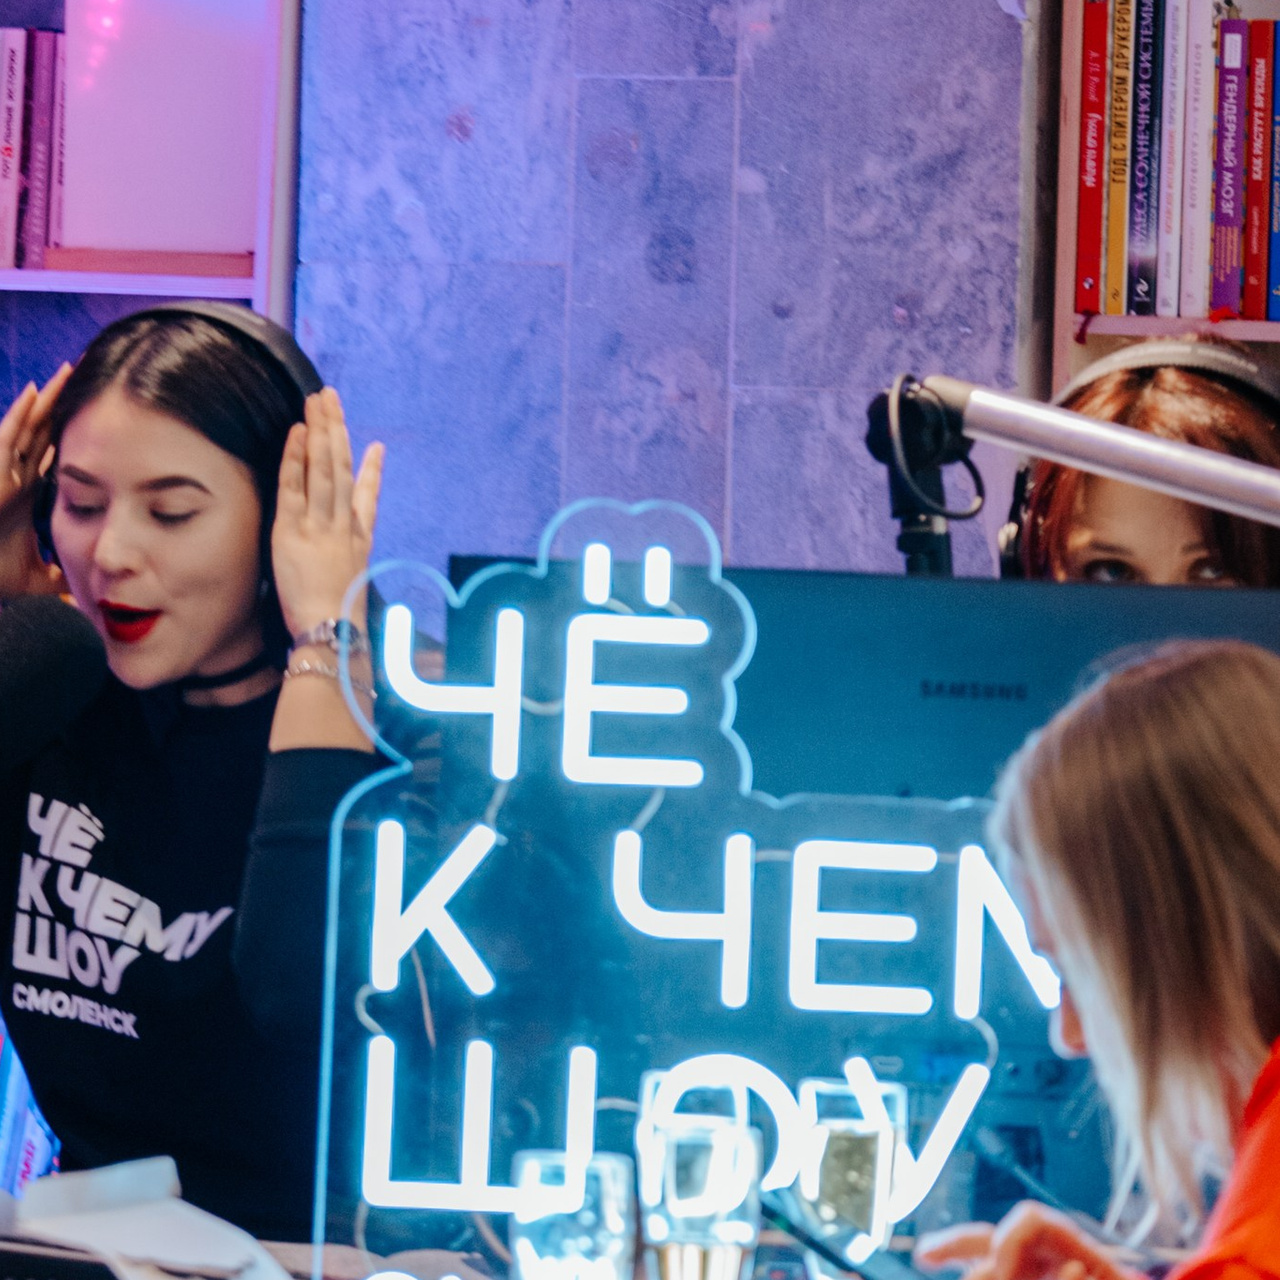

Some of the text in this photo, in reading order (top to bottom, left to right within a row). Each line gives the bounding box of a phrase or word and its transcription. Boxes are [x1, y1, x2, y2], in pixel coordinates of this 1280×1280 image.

[1113, 76, 1129, 139] ПИТЕРОМ
[1132, 83, 1151, 189] СОЛНЕЧНОЙ
[1221, 74, 1239, 167] ГЕНДЕРНЫЙ
[1112, 158, 1127, 184] ГОД
[1220, 170, 1235, 217] МОЗГ
[382, 541, 710, 787] ЧЁ
[920, 678, 1029, 703] SAMSUNG
[16, 852, 236, 963] К ЧЕМУ
[370, 819, 499, 997] К
[11, 910, 142, 996] ШОУ
[11, 982, 141, 1040] СМОЛЕНСК
